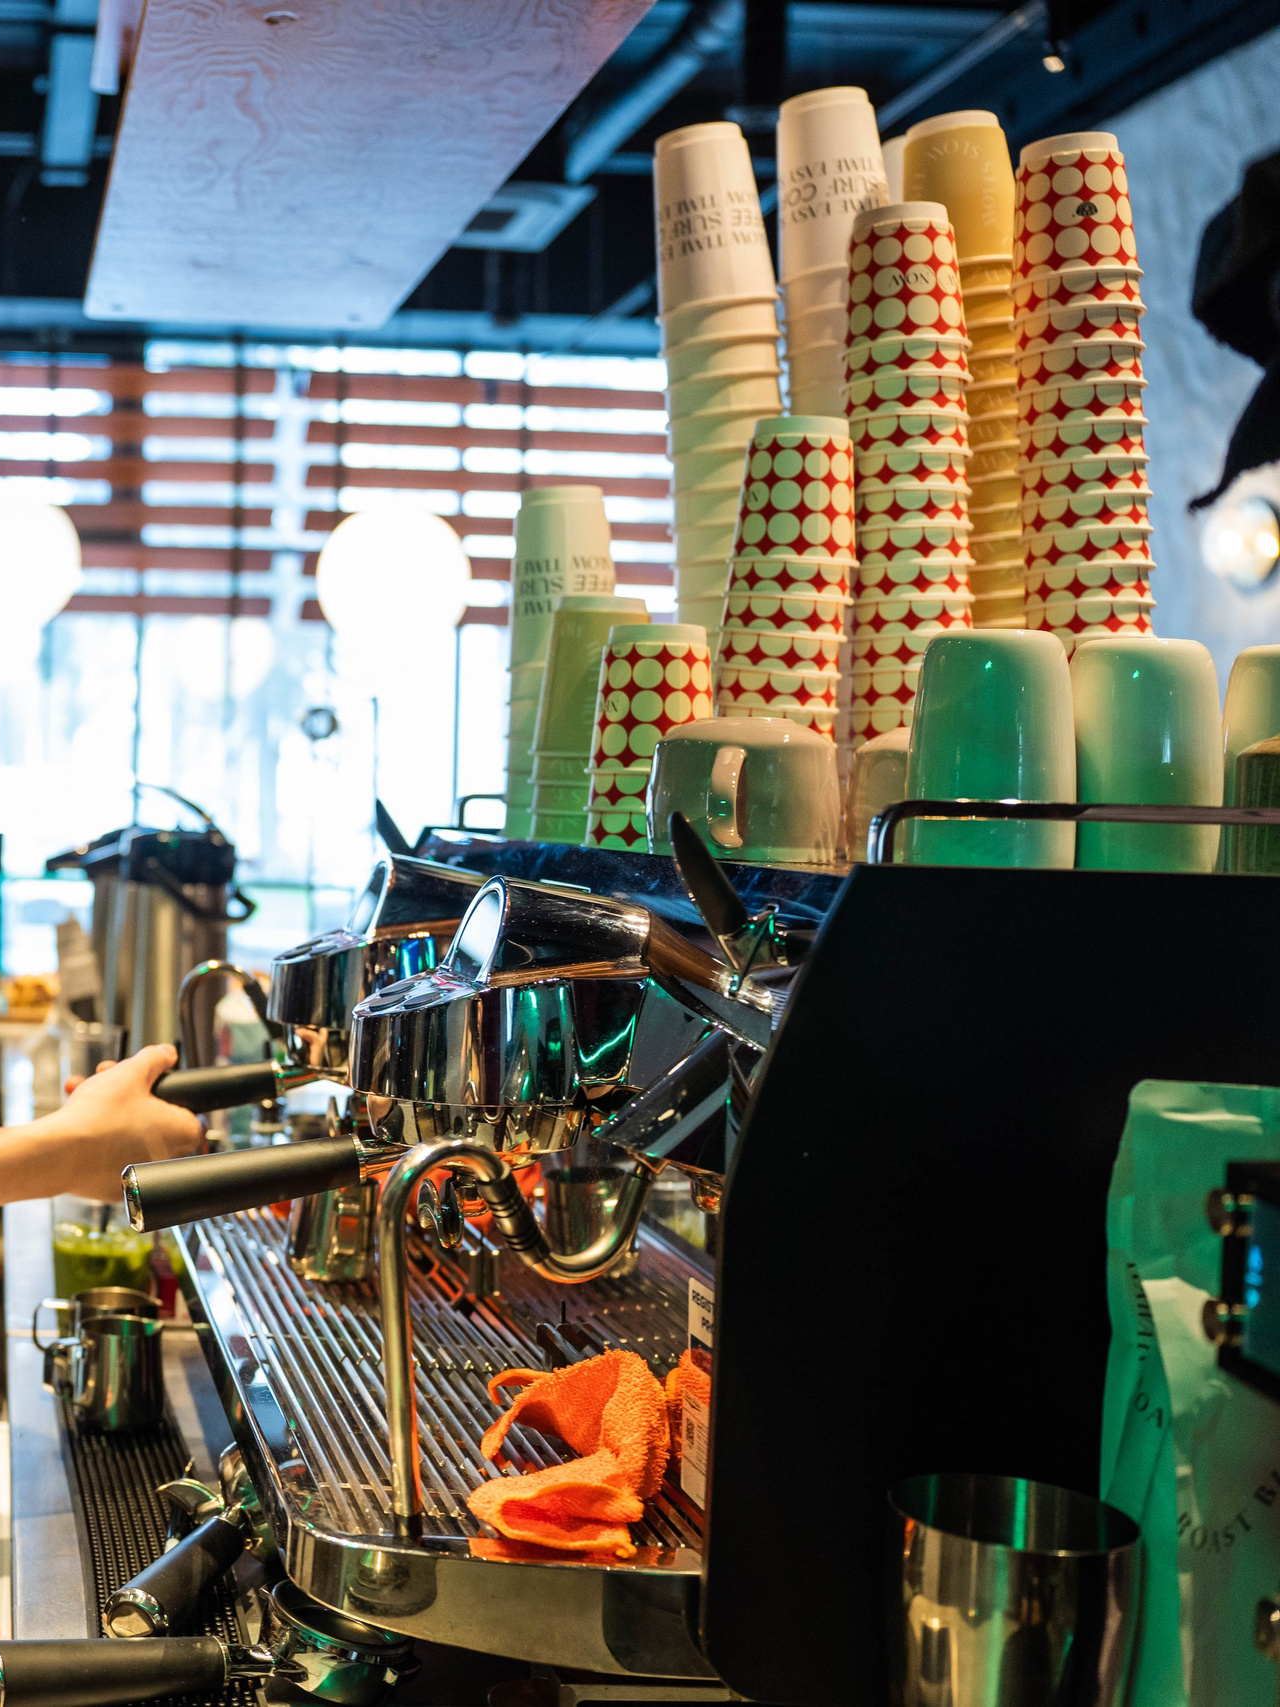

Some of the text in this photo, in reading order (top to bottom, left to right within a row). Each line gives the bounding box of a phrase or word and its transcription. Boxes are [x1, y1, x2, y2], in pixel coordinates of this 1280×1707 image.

[826, 175, 879, 196] SURF
[671, 210, 723, 239] SURF
[884, 270, 931, 290] NOW
